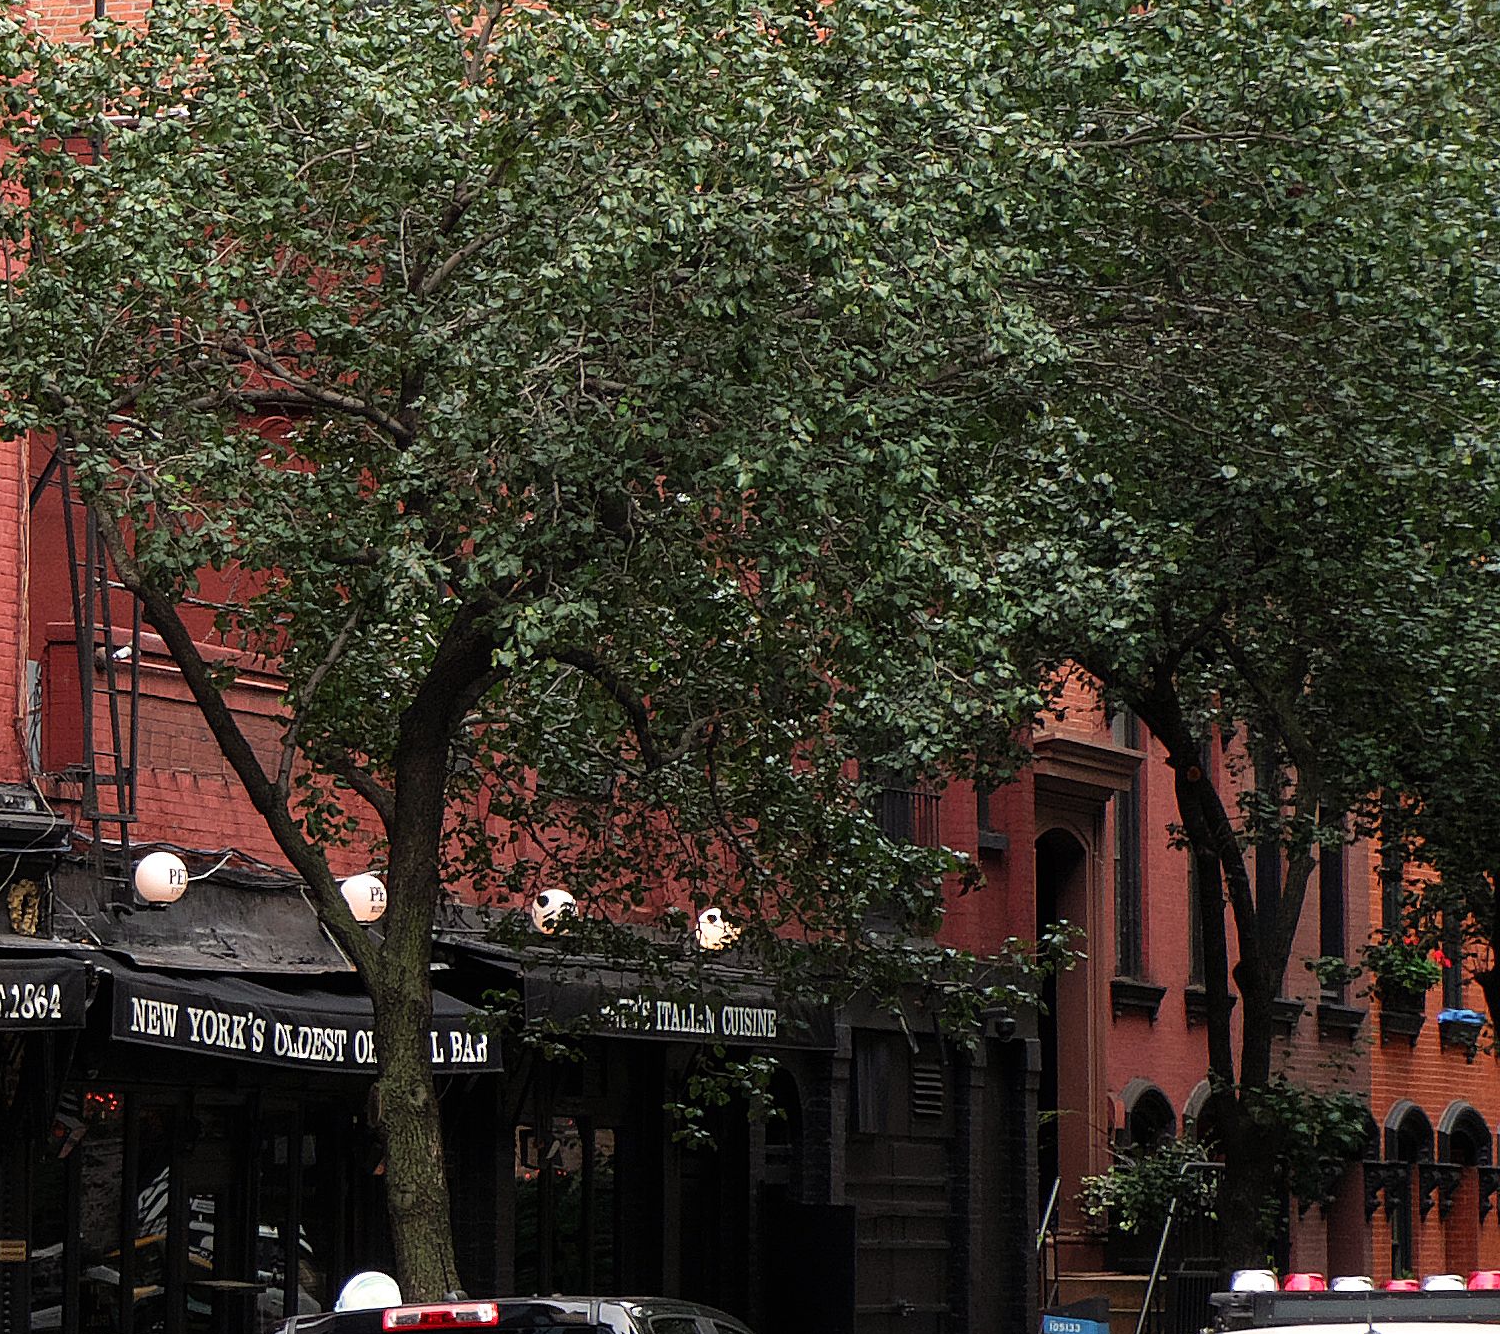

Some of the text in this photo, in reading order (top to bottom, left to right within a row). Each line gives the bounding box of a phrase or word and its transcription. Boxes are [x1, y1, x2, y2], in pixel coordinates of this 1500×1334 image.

[131, 997, 179, 1038] NEW
[187, 1006, 267, 1052] YORK'S
[274, 1023, 348, 1062] OLDEST
[722, 1005, 777, 1037] CUISINE
